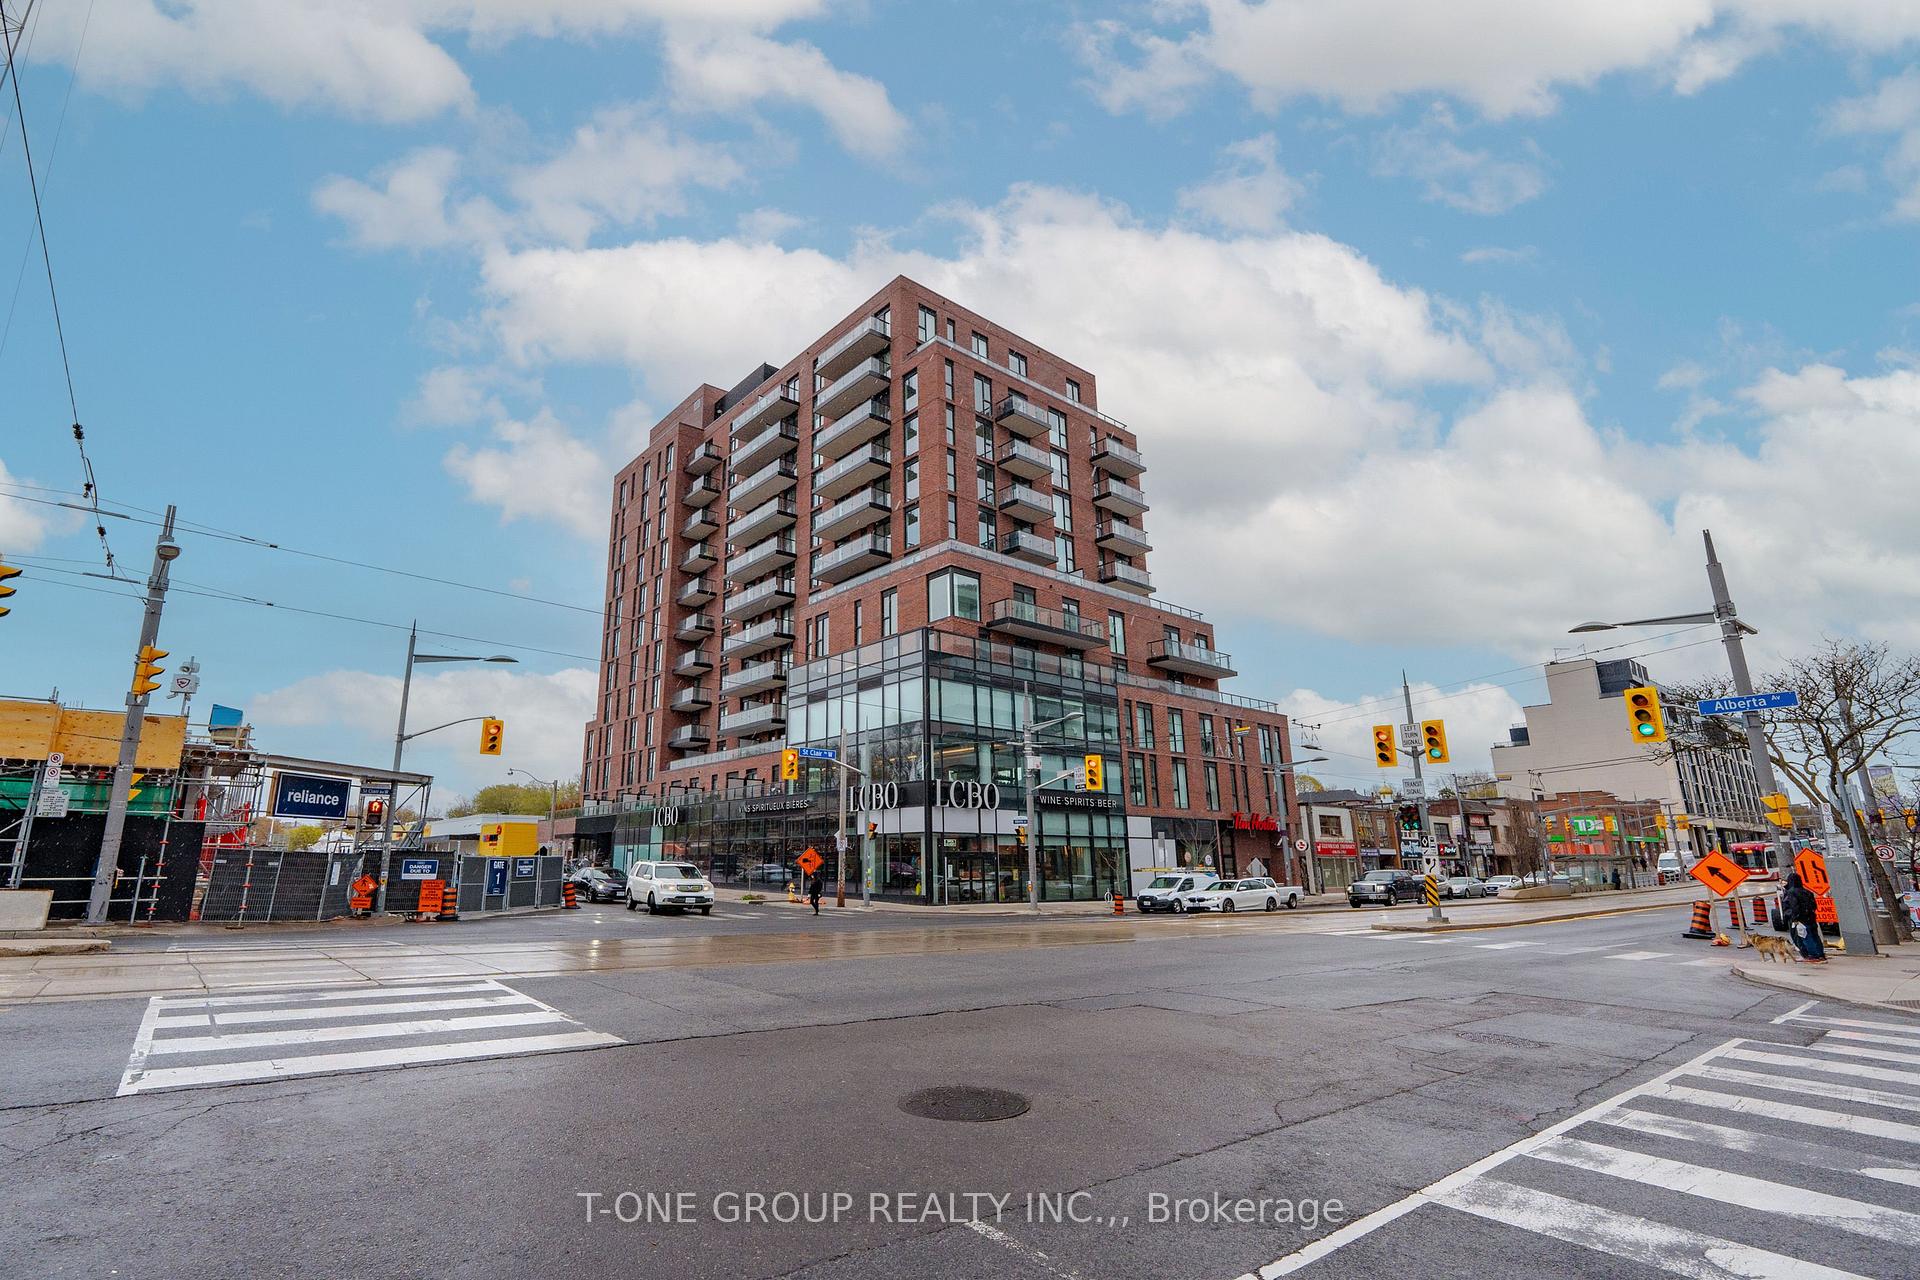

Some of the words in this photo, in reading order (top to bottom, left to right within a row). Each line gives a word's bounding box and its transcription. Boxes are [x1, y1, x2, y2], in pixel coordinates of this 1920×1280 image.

[1714, 698, 1767, 711] Alberta
[809, 749, 822, 757] Clair
[287, 789, 339, 805] reliance
[850, 781, 899, 812] LCBO
[936, 778, 1000, 810] LCBO
[1039, 795, 1062, 805] WINE
[1064, 797, 1095, 807] SPIRITS
[1097, 799, 1117, 808] BEER
[653, 806, 679, 827] LCBO
[1231, 811, 1250, 830] Tim
[1250, 813, 1278, 831] Horton
[493, 860, 505, 869] GATE
